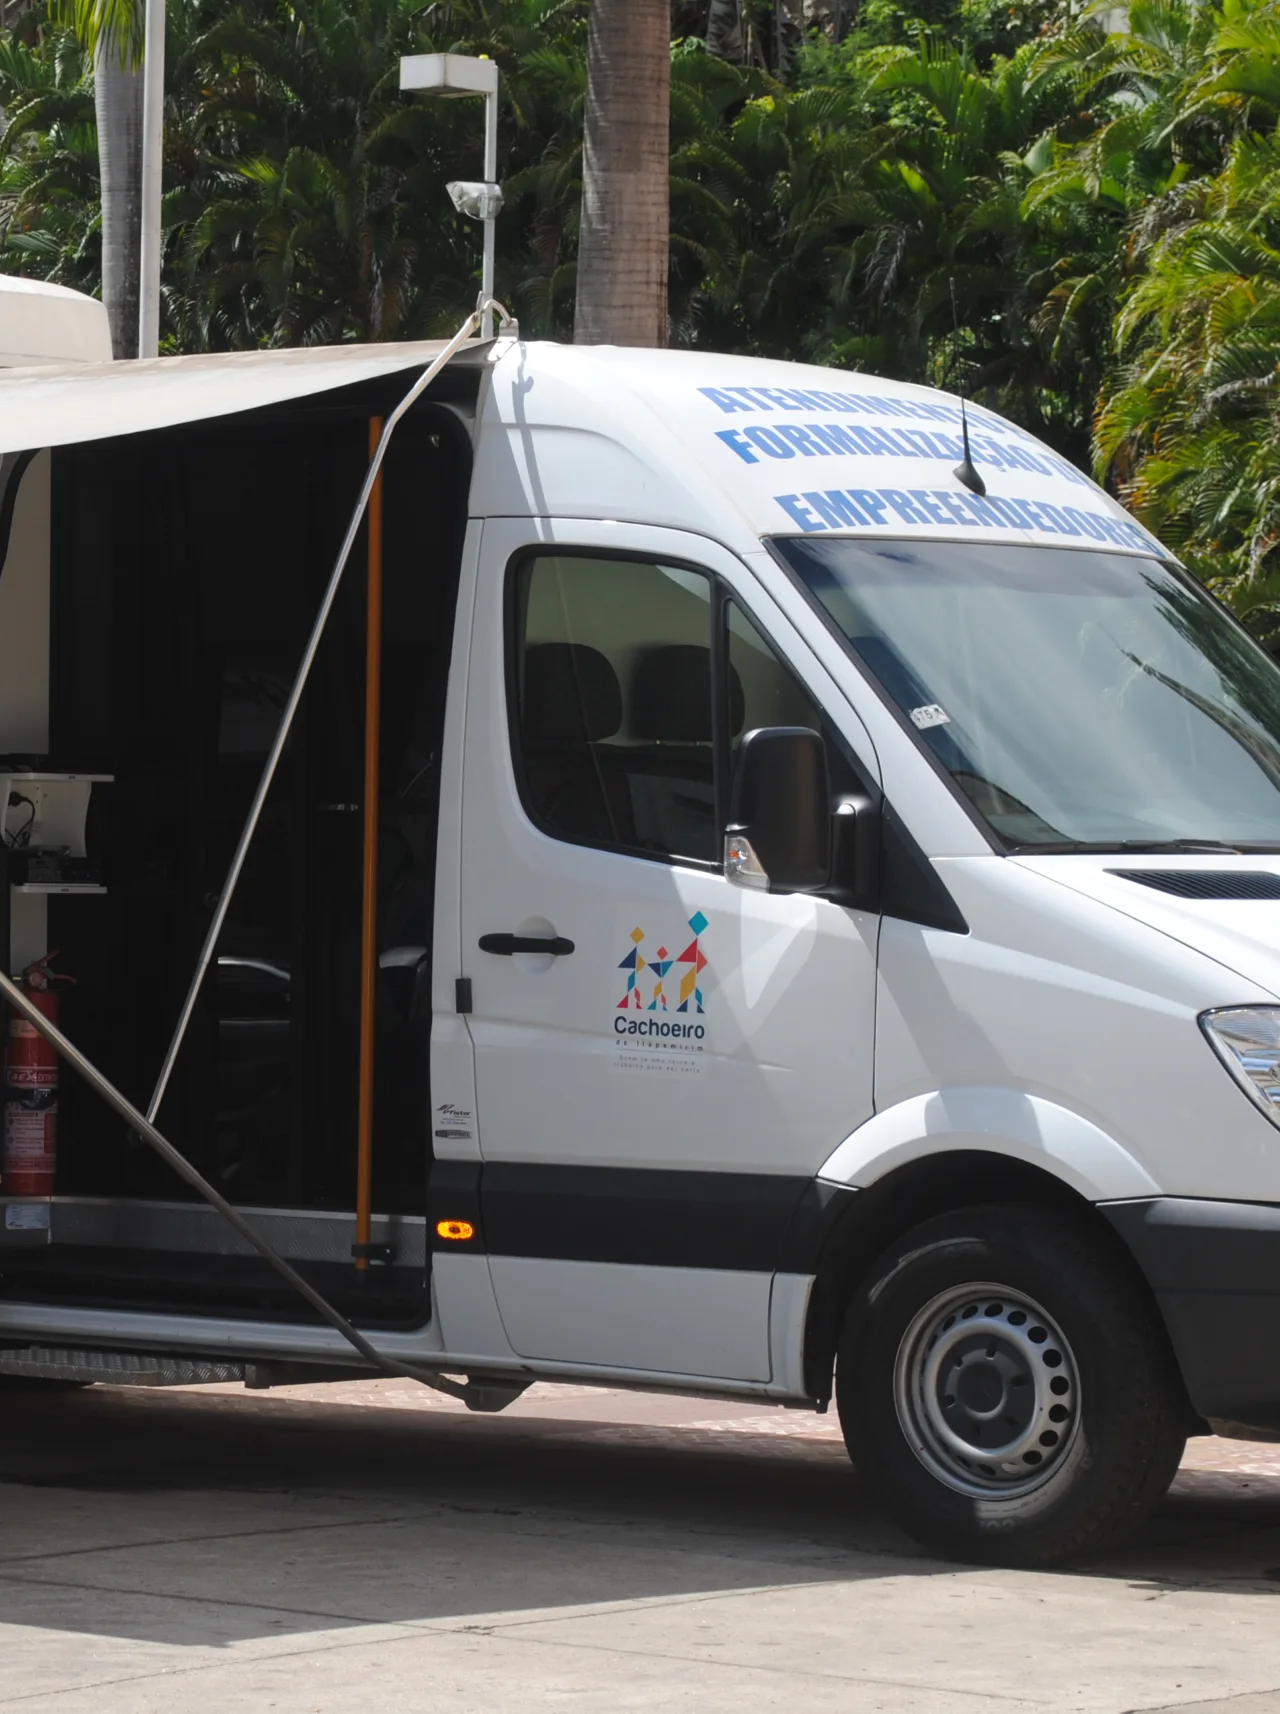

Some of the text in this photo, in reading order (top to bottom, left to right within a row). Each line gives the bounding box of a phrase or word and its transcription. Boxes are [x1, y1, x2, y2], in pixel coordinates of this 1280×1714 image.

[714, 423, 1053, 477] FORMALIZAÇÃO
[773, 489, 1166, 558] EMPREENDEDORES
[614, 1015, 705, 1039] Cachoeiro
[636, 1040, 704, 1051] Itapemirim
